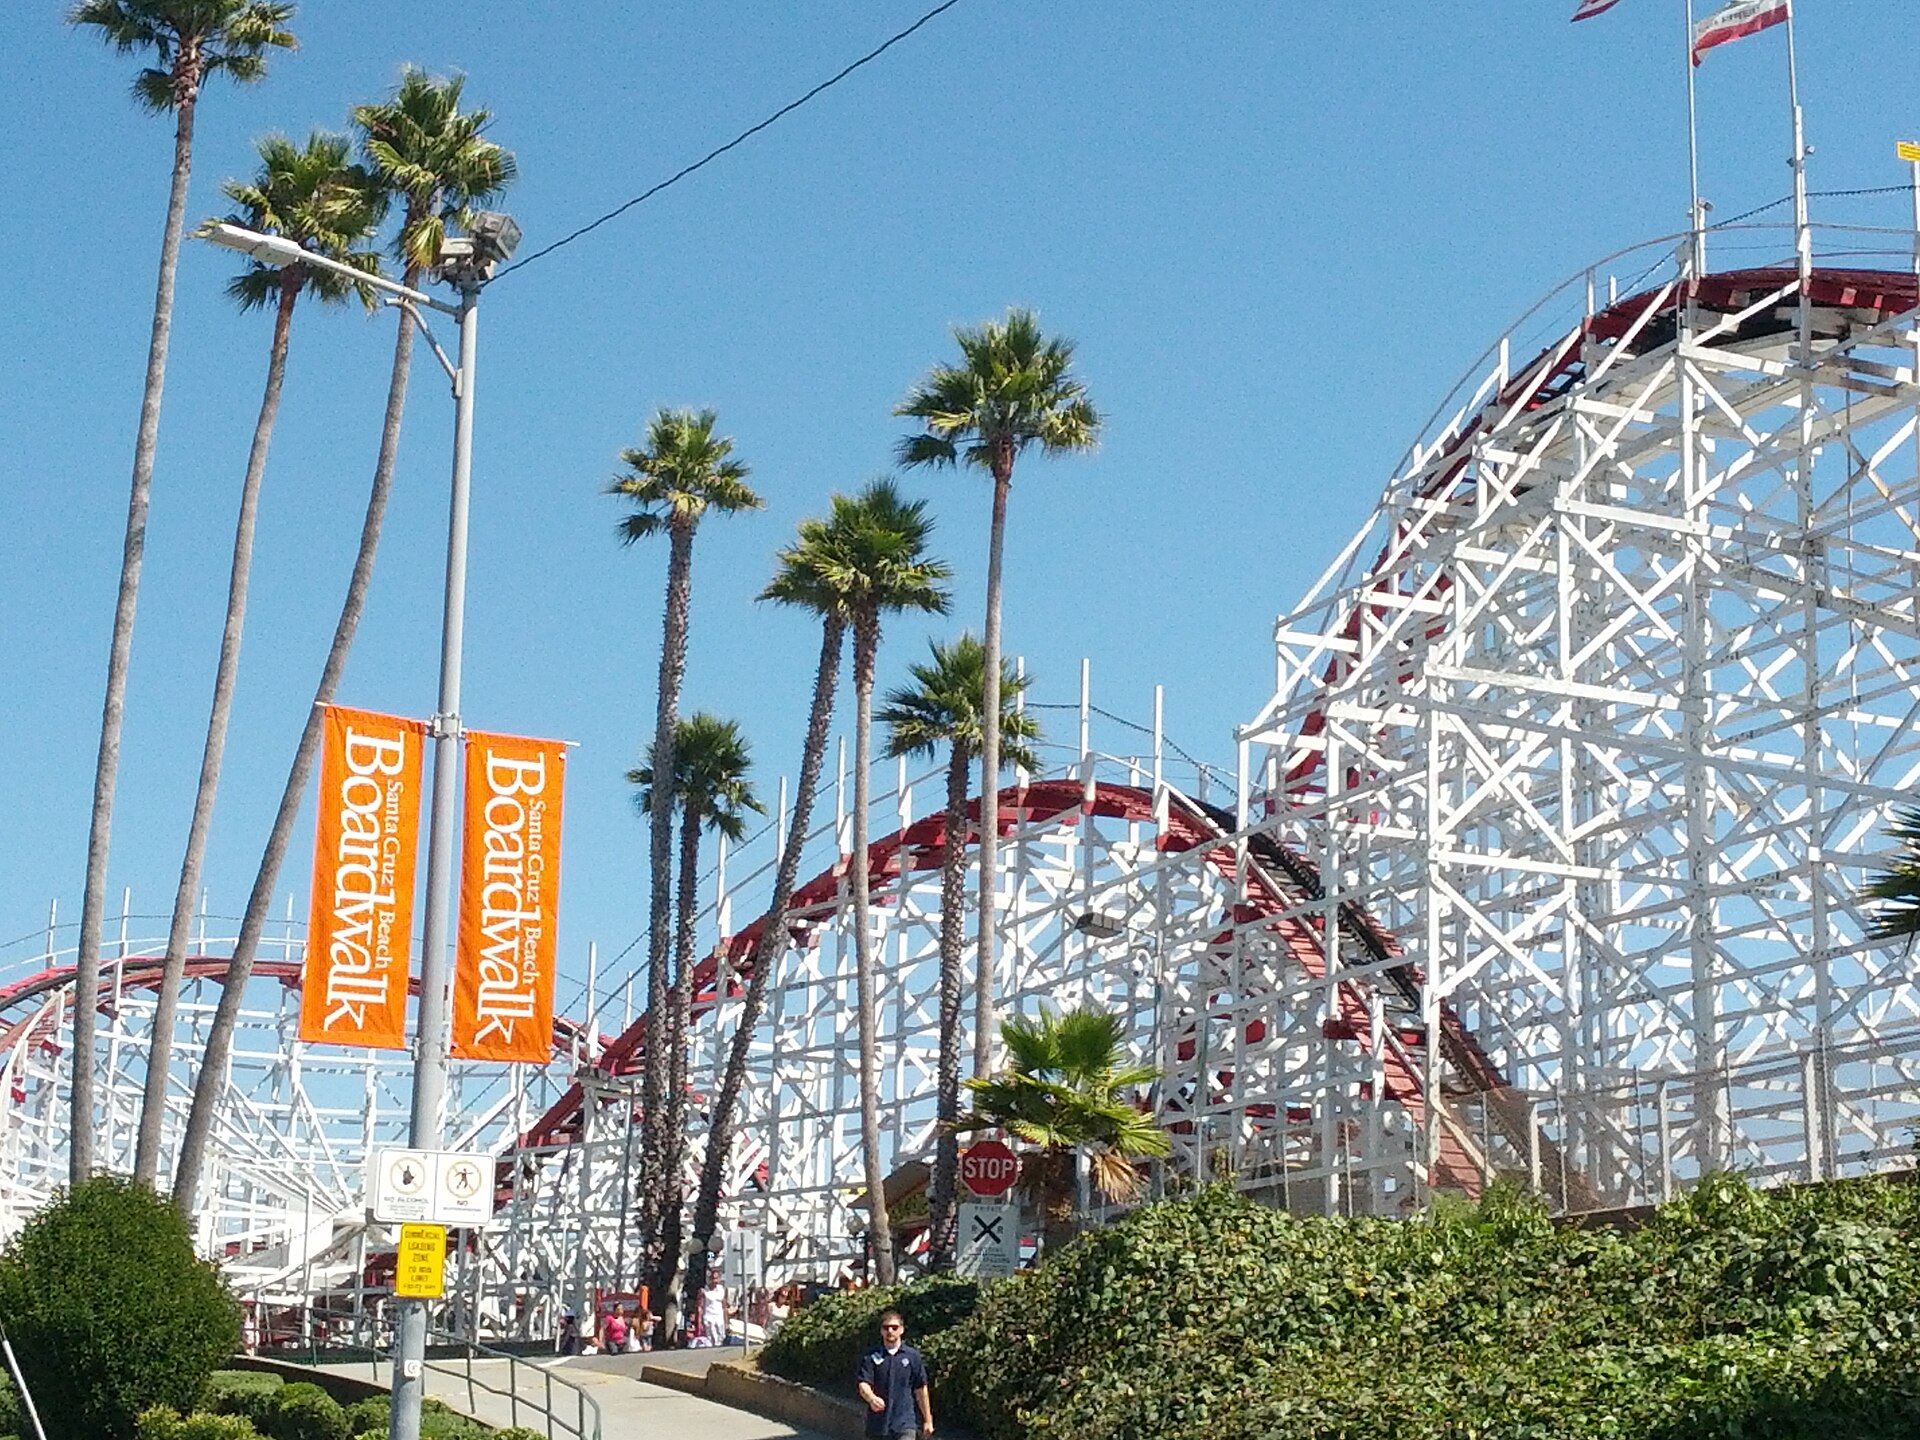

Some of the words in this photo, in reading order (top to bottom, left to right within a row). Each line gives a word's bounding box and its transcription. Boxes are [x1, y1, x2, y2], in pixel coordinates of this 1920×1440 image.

[384, 779, 404, 833] Santa
[528, 800, 547, 851] Santa
[324, 726, 405, 1031] Boardwalk
[381, 838, 401, 886] Cruz
[527, 855, 545, 903] Cruz
[473, 749, 546, 1046] Boardwalk
[375, 911, 396, 968] Beach
[522, 927, 542, 984] Beach
[964, 1156, 1014, 1179] STOP
